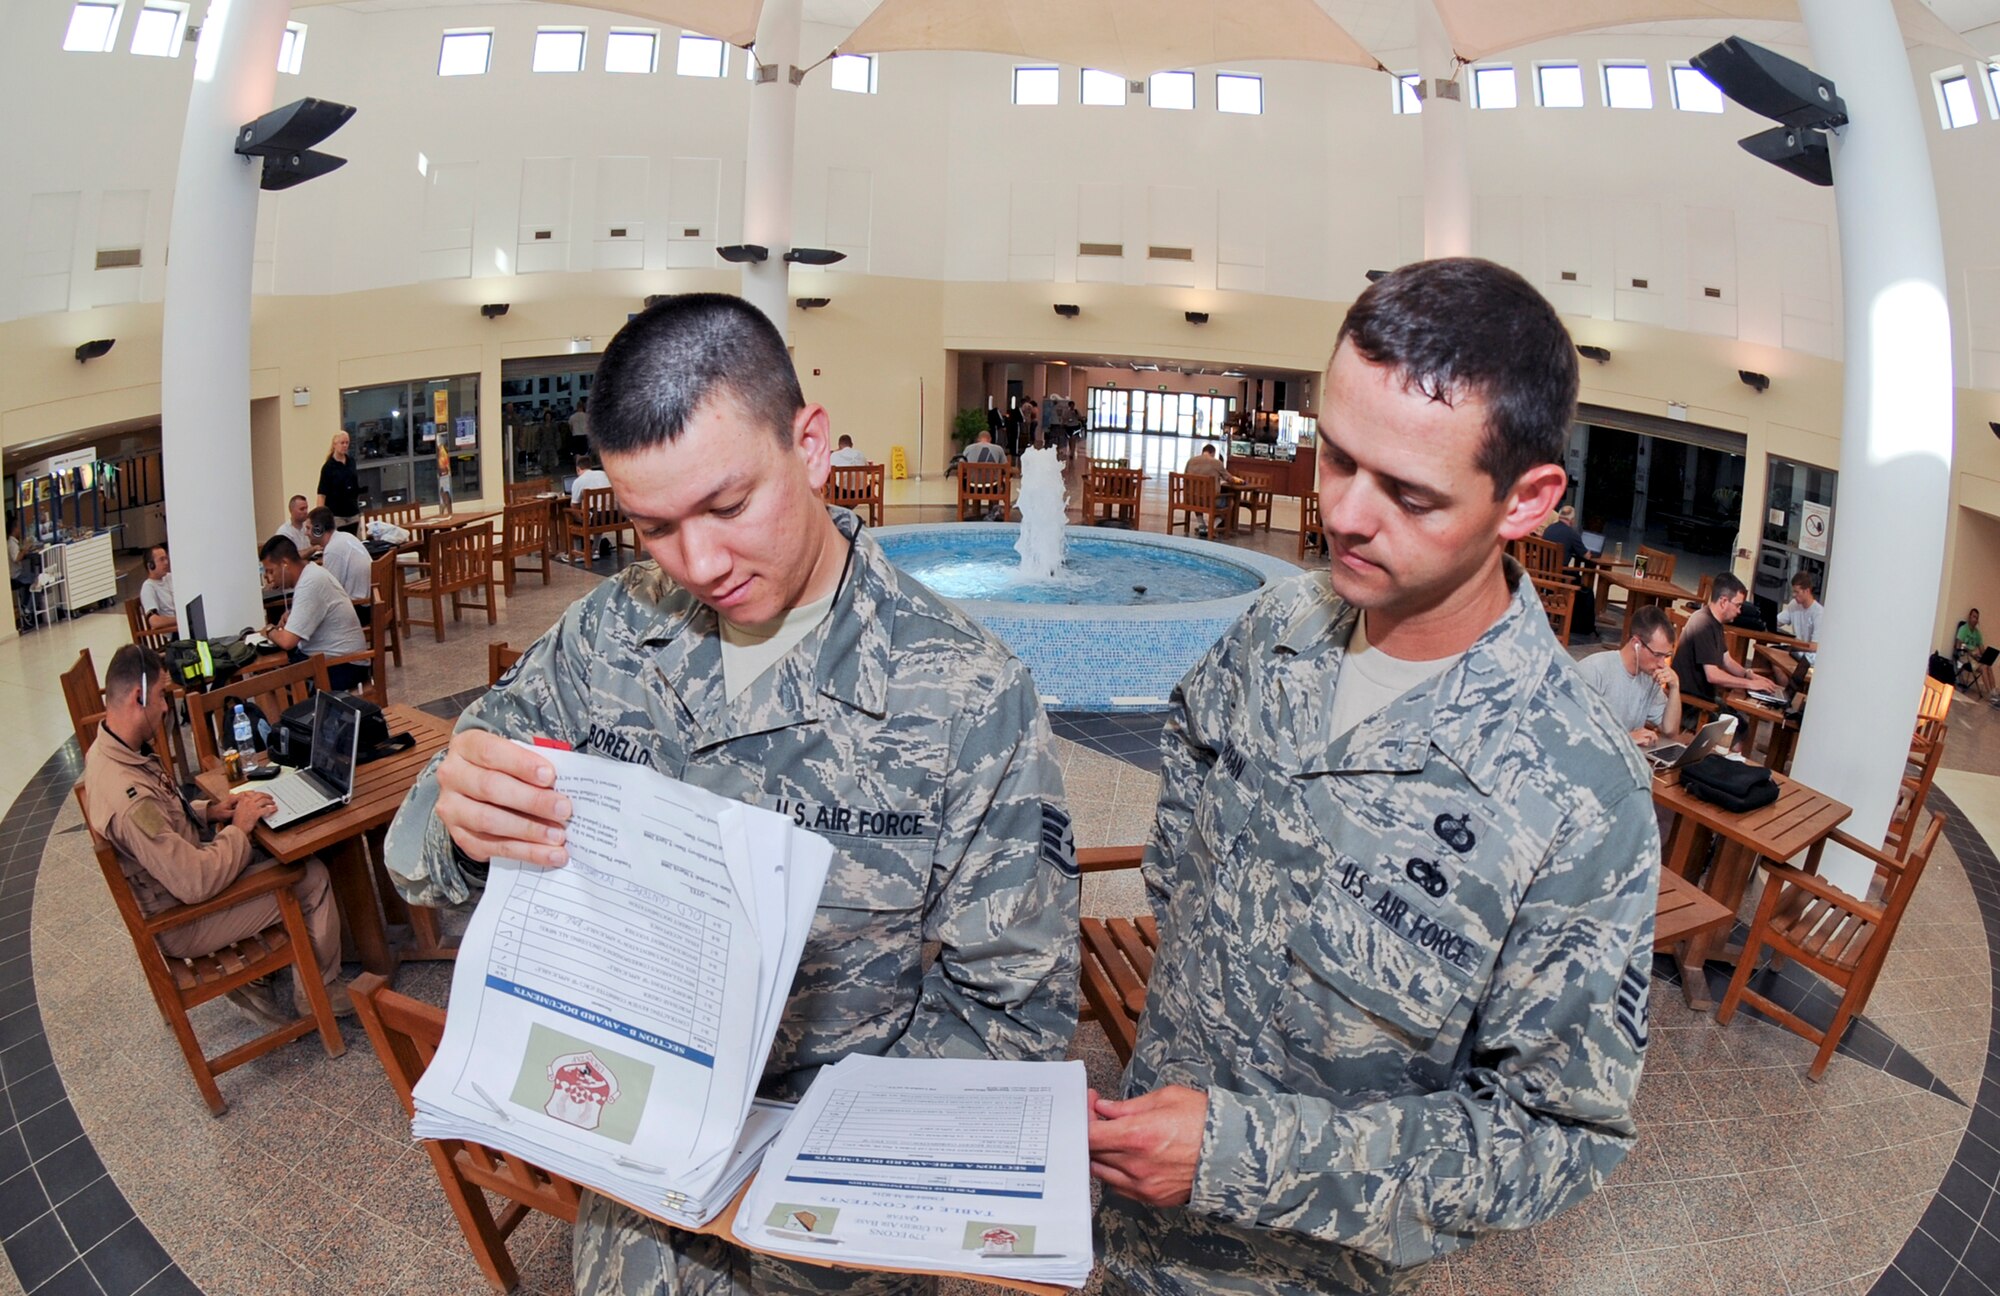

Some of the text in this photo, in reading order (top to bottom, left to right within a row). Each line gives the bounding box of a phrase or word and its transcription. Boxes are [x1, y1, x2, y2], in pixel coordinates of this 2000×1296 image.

[588, 723, 649, 765] BORELLO
[814, 805, 851, 832] AIR
[859, 810, 925, 836] FORCE
[674, 902, 703, 922] OLD
[1341, 863, 1475, 967] U.S. AIR FORCE
[512, 985, 579, 1015] DOCUMENTS
[627, 999, 649, 1011] REVIEW
[642, 991, 692, 1013] PURCHASE ORDER
[579, 1009, 620, 1030] AWARD
[649, 1007, 690, 1026] CONTRACTING
[628, 1027, 637, 1036] B
[635, 1030, 686, 1054] SECTION
[814, 1155, 883, 1163] DOCUMENTS
[885, 1159, 953, 1167] PRE-AWARD
[819, 1196, 994, 1216] TABLE OF CONTENTS
[854, 1218, 878, 1226] BASE
[880, 1220, 897, 1228] AIR
[885, 1212, 919, 1221] QATAR
[868, 1228, 927, 1240] 379 ECONS
